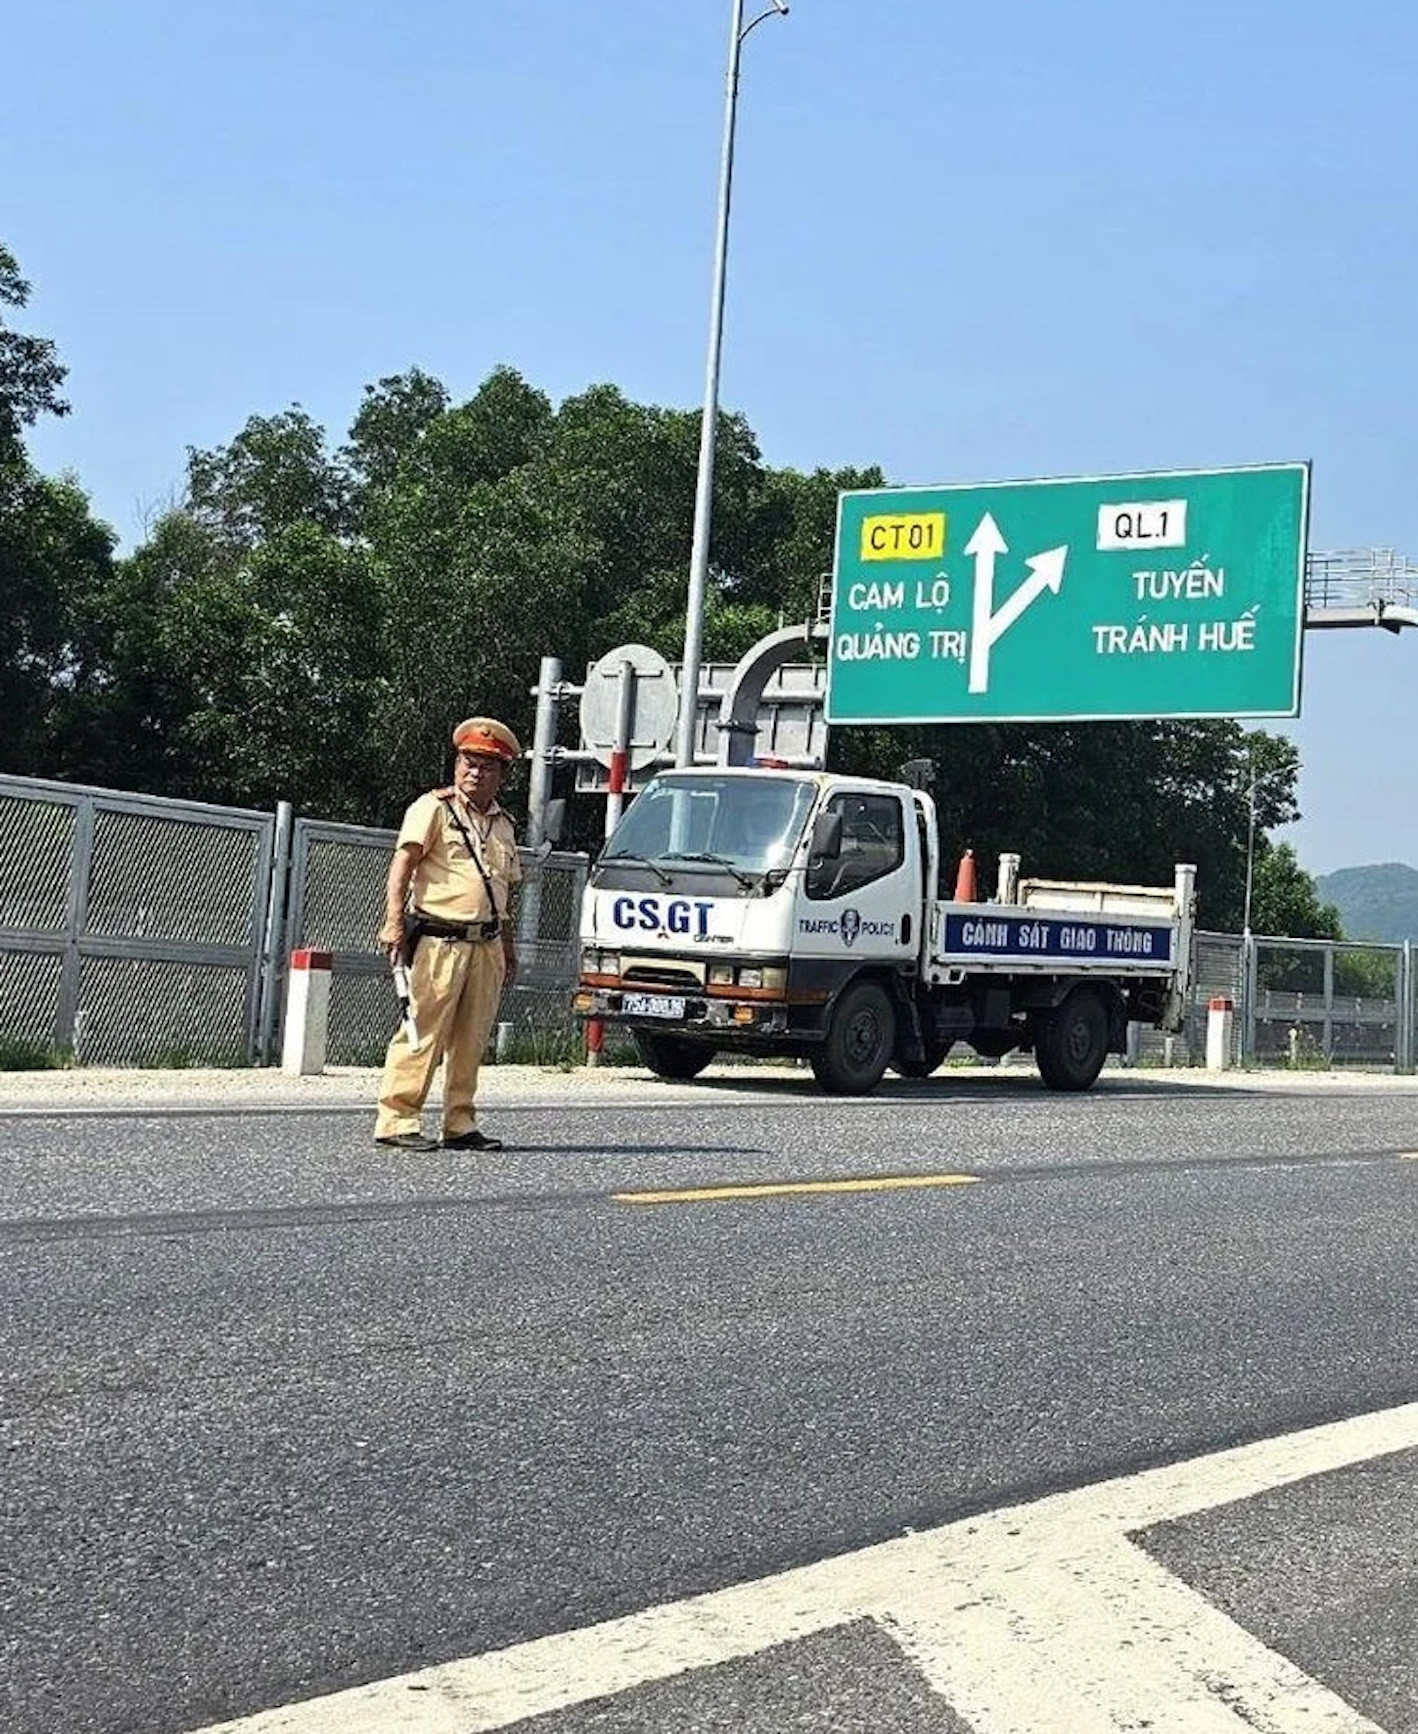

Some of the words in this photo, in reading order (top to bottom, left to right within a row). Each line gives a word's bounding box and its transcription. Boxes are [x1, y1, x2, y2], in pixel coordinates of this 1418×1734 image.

[871, 523, 933, 550] CT01
[1115, 511, 1168, 538] QL.1
[848, 581, 904, 610] CAM
[916, 571, 950, 614] LỘ
[1132, 553, 1224, 600] TUYẾN
[837, 621, 920, 661] QUẢNG
[928, 631, 967, 664] TRỊ
[1092, 614, 1188, 654] TRÁNH
[1198, 604, 1261, 651] HUẾ
[800, 919, 839, 934] TRAFFIC
[861, 921, 895, 936] POLICE
[962, 917, 1008, 947] CẢNH
[1018, 921, 1050, 949] SÁT
[1060, 926, 1096, 951] GIAO
[1106, 927, 1153, 953] THÔNG
